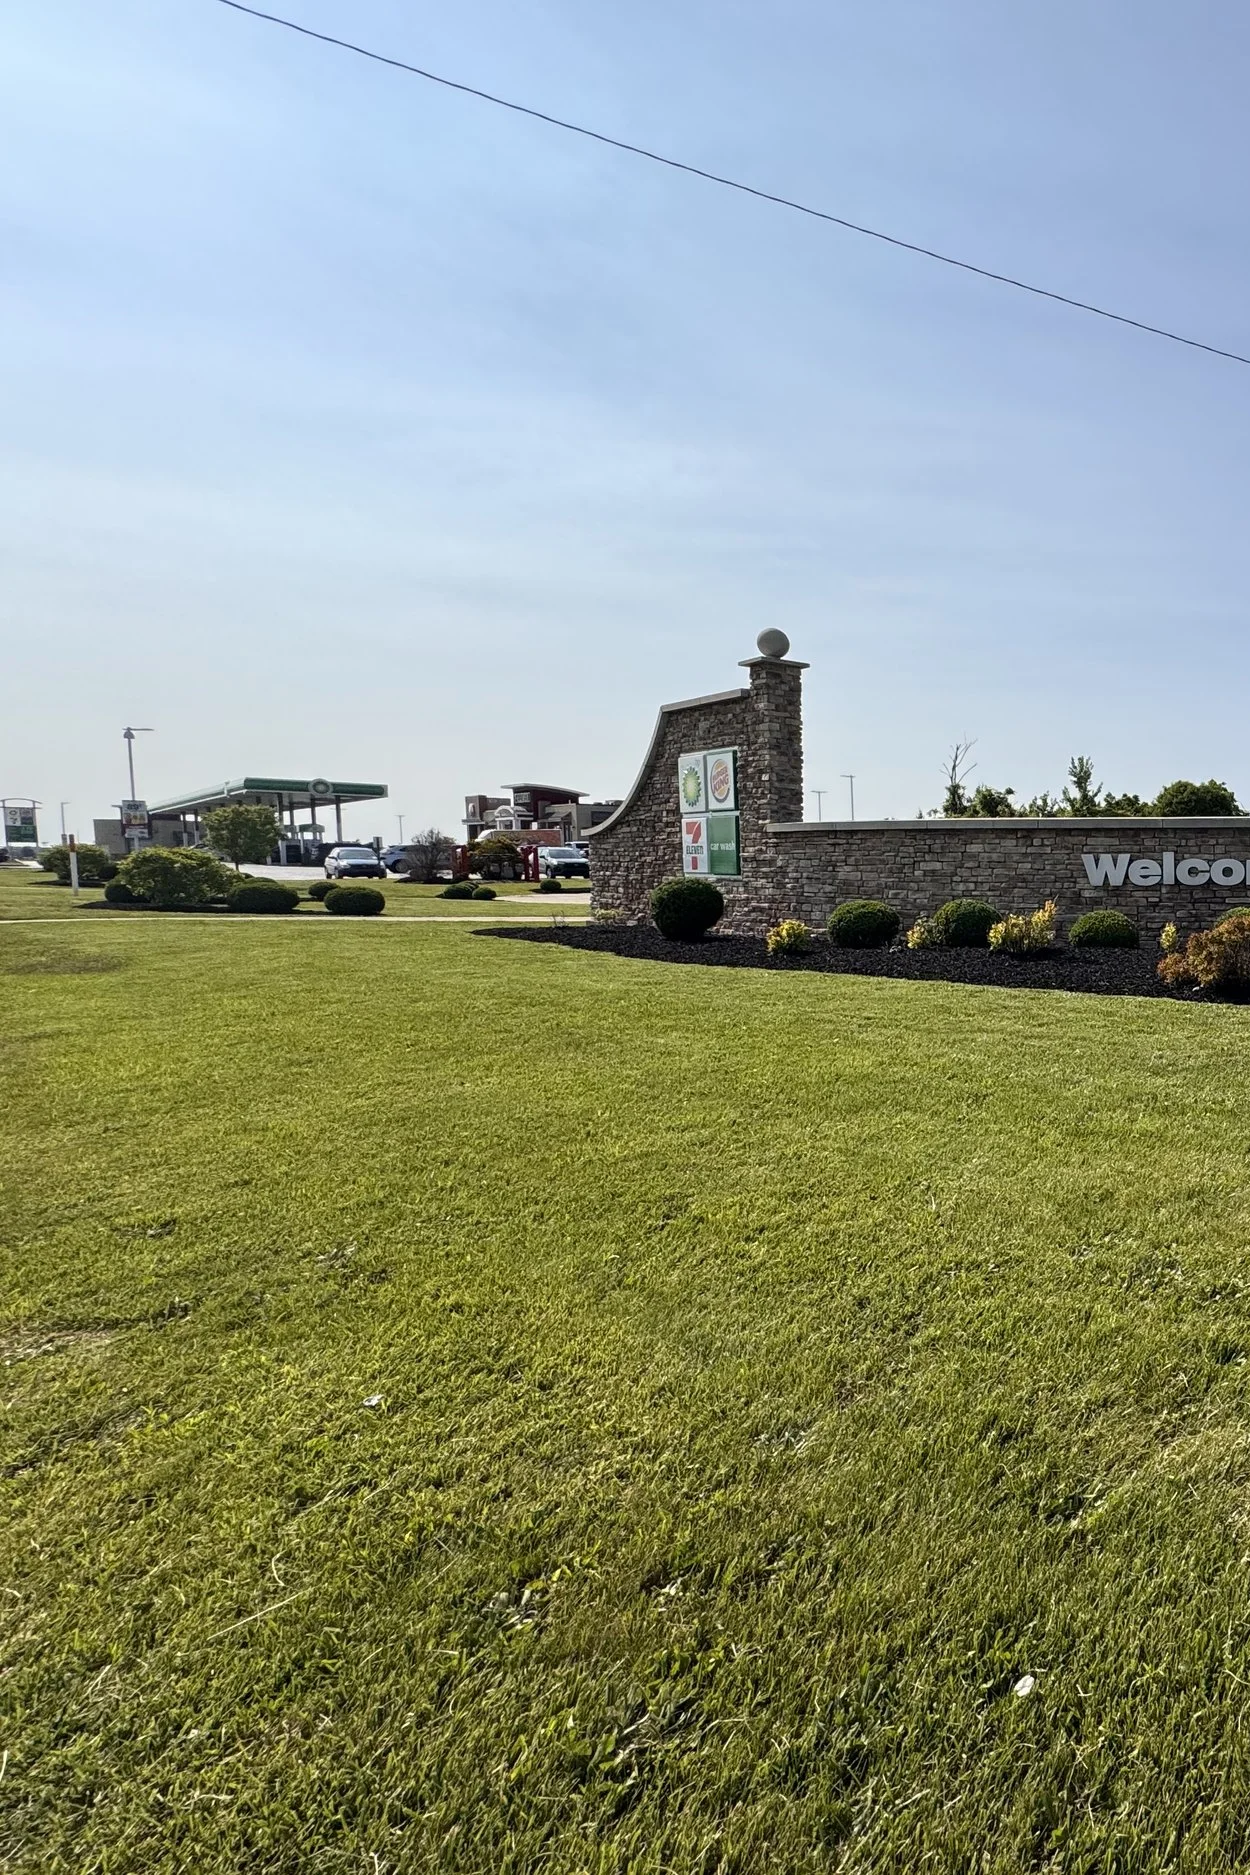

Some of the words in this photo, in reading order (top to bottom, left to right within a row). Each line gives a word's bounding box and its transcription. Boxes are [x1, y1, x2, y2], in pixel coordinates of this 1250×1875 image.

[713, 773, 729, 794] KING
[710, 843, 719, 851] car
[720, 839, 735, 851] wash
